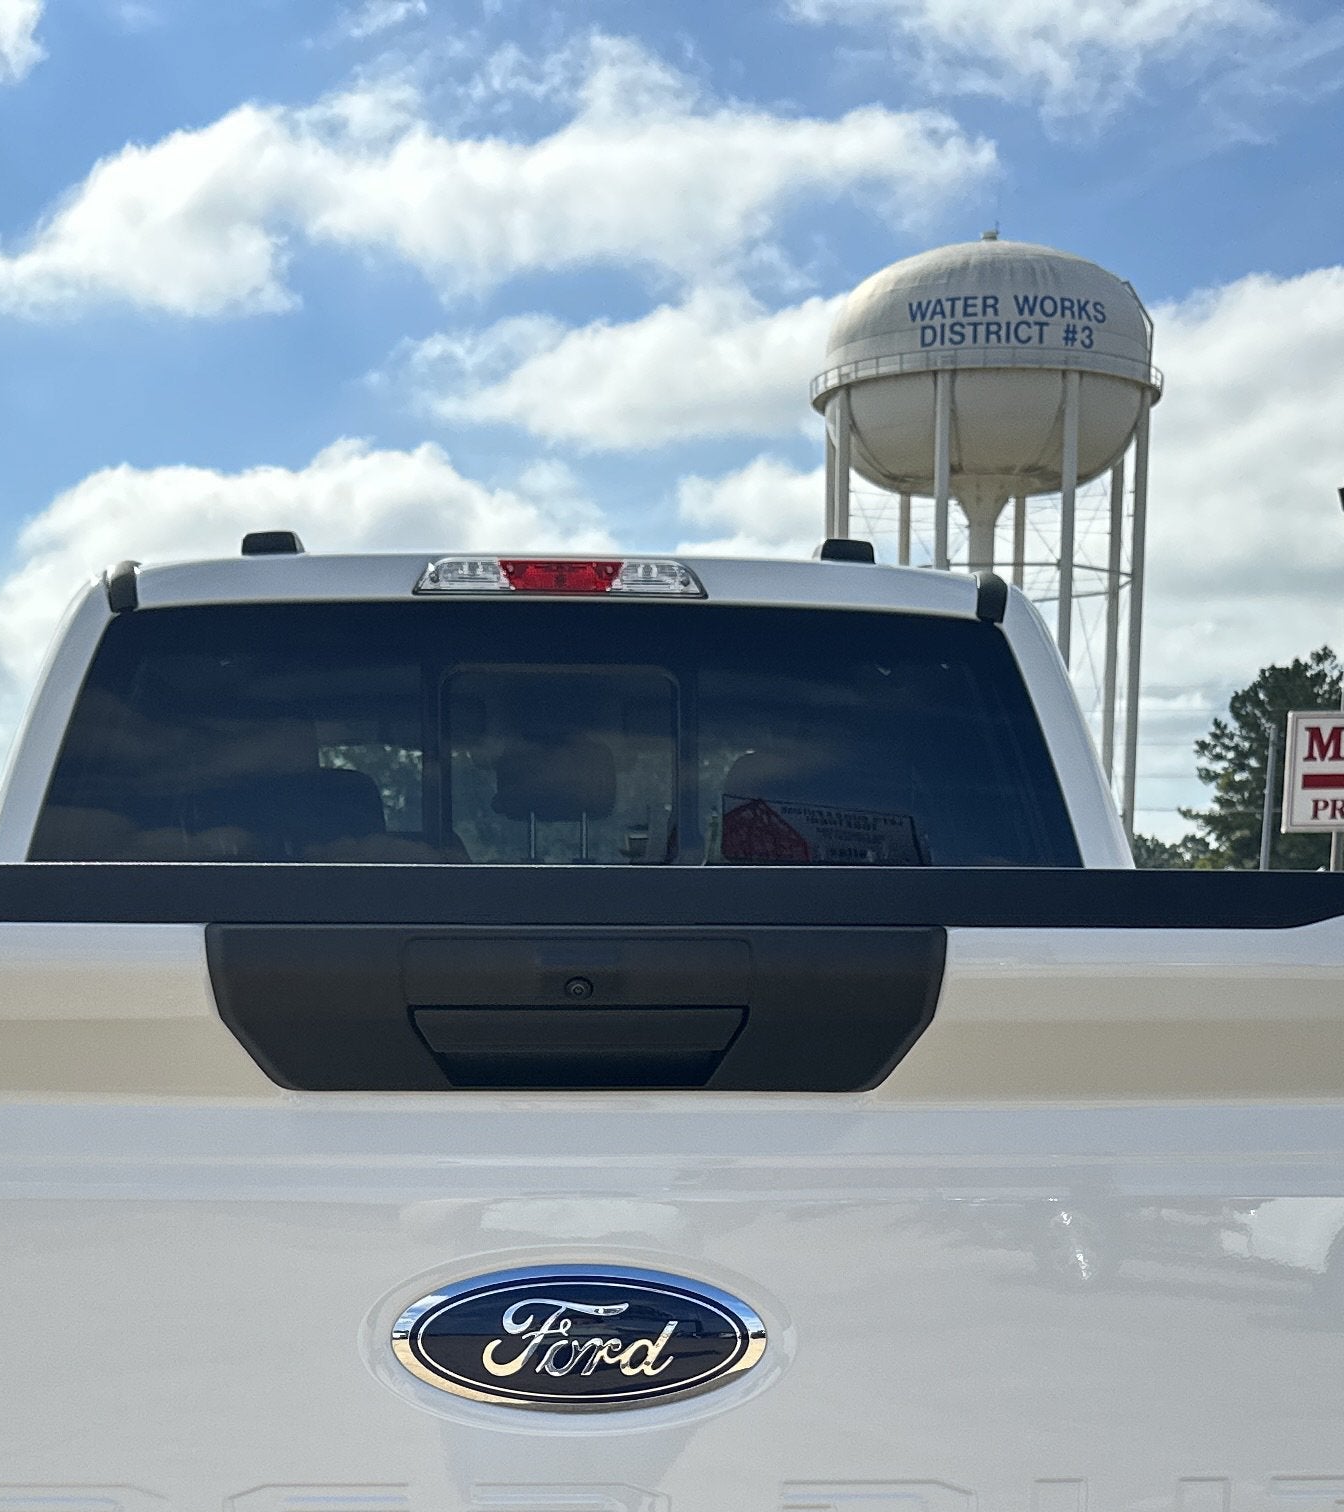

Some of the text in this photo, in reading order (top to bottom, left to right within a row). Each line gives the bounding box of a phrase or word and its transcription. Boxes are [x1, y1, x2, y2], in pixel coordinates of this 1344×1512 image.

[908, 294, 1106, 324] WATER WORKS
[919, 321, 1095, 349] DISTRICT #3
[482, 1298, 674, 1378] Ford
